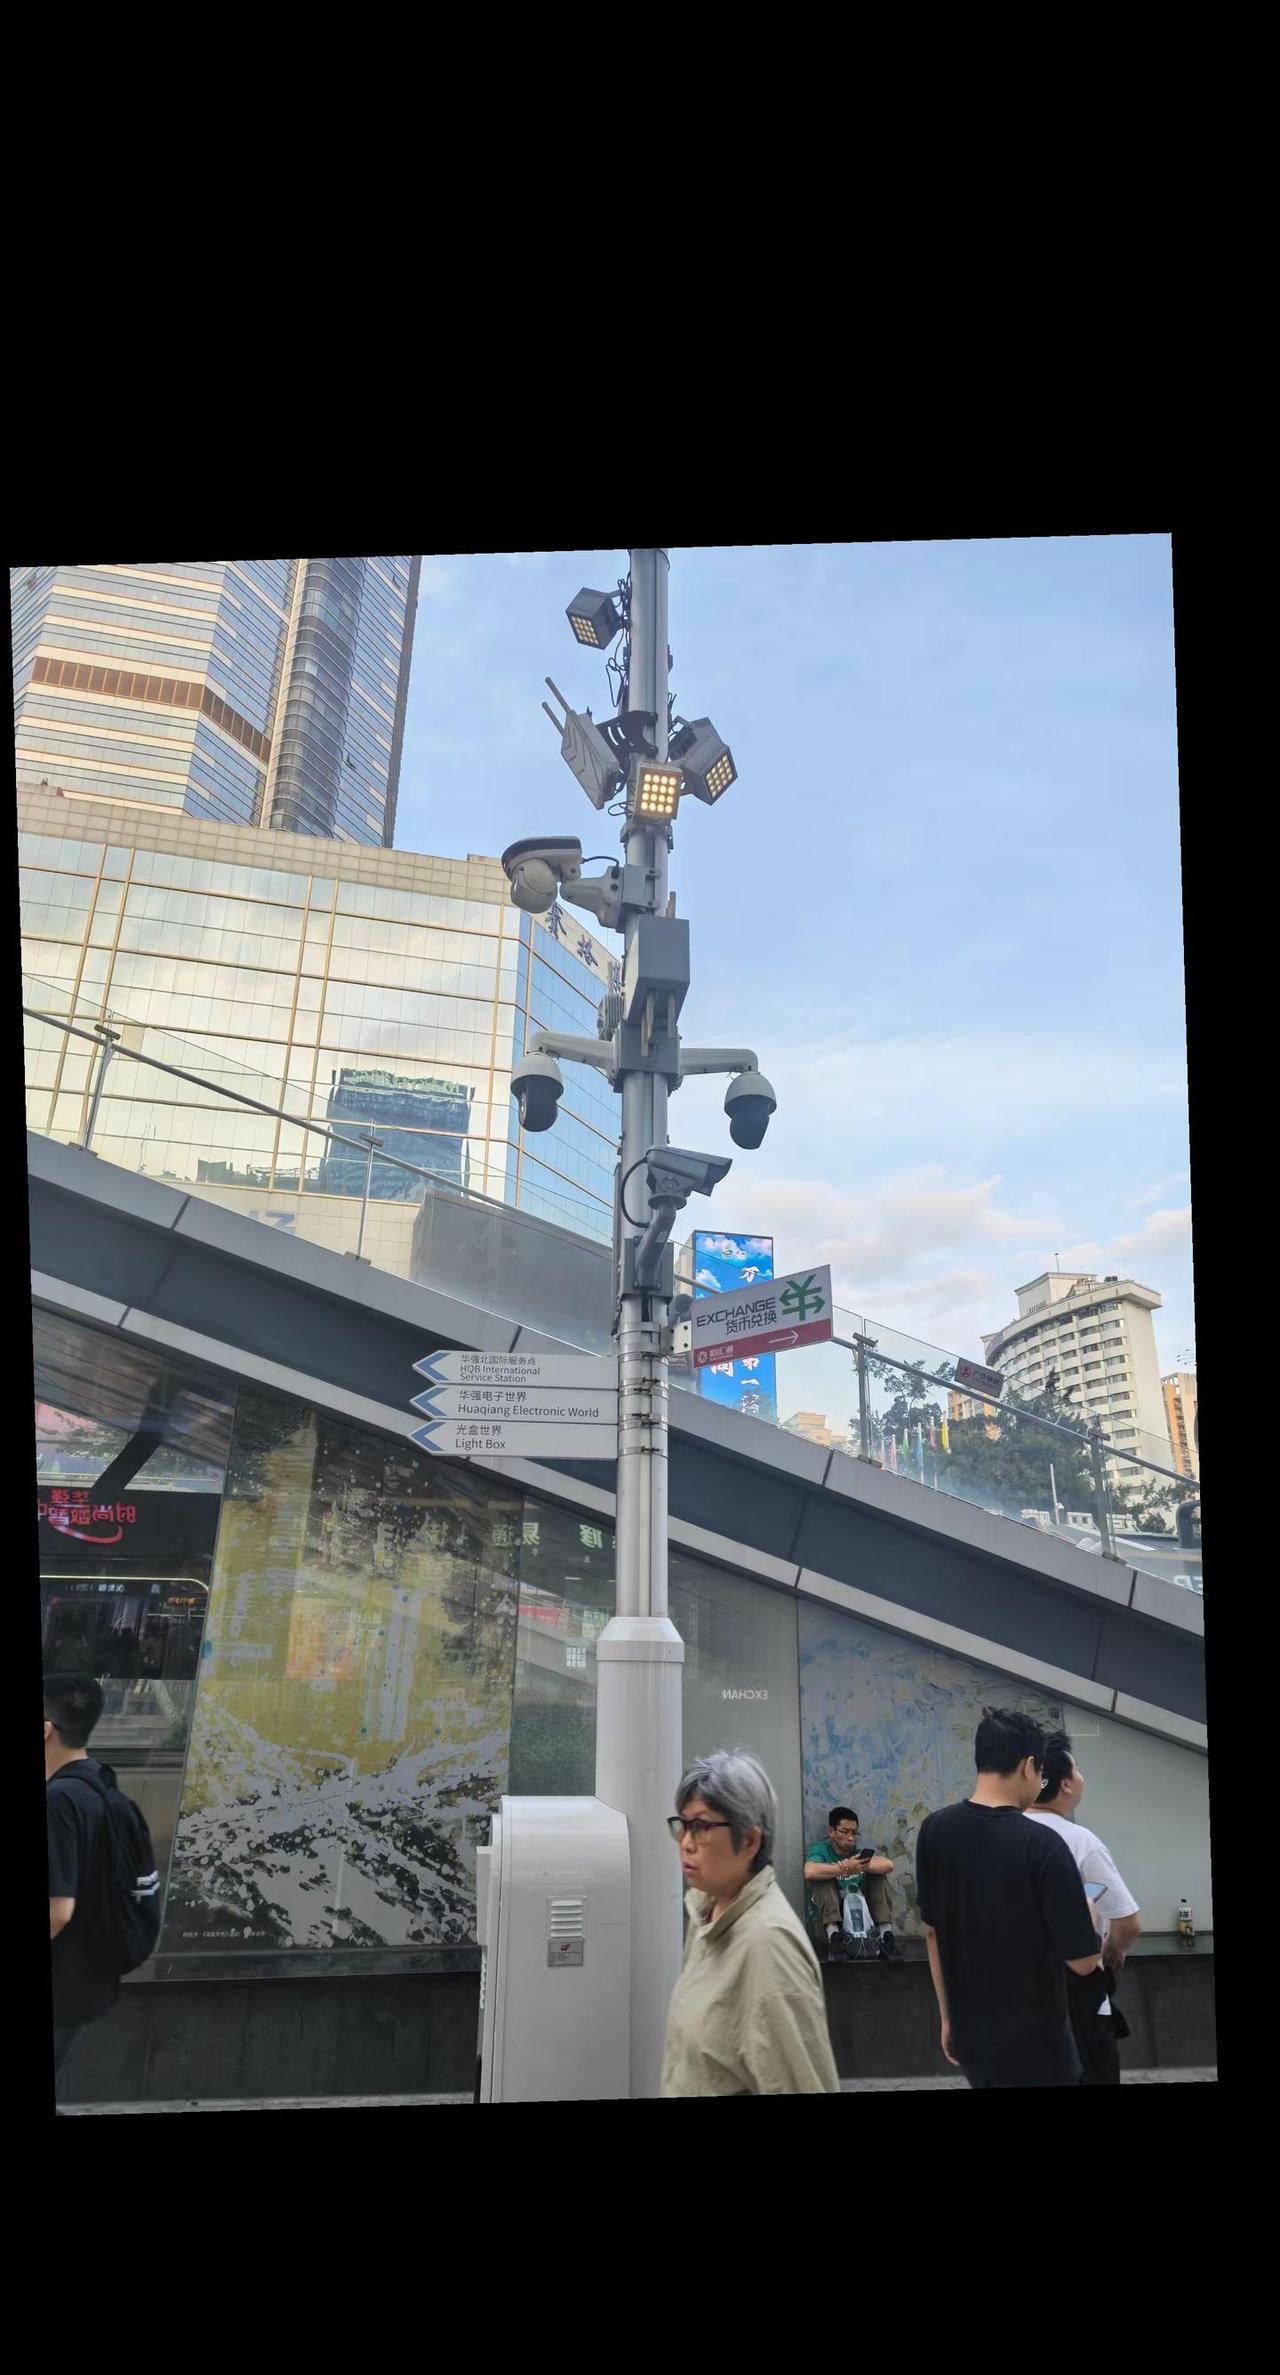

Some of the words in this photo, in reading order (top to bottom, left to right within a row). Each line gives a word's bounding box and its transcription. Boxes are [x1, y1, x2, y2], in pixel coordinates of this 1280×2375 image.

[696, 1297, 776, 1327] EXCHANGE
[725, 1310, 777, 1335] 货币兑换
[461, 1354, 537, 1366] 华强北国际服务点
[460, 1364, 481, 1374] HQB
[482, 1365, 540, 1376] International
[460, 1372, 493, 1382] Service
[494, 1373, 527, 1383] Station
[459, 1390, 527, 1402] 华强电子世界
[458, 1403, 510, 1417] Huaqiang
[512, 1405, 566, 1417] Electronic
[568, 1407, 599, 1418] World
[456, 1424, 502, 1436] 光盒世界
[455, 1438, 483, 1451] Light
[485, 1439, 506, 1449] Box
